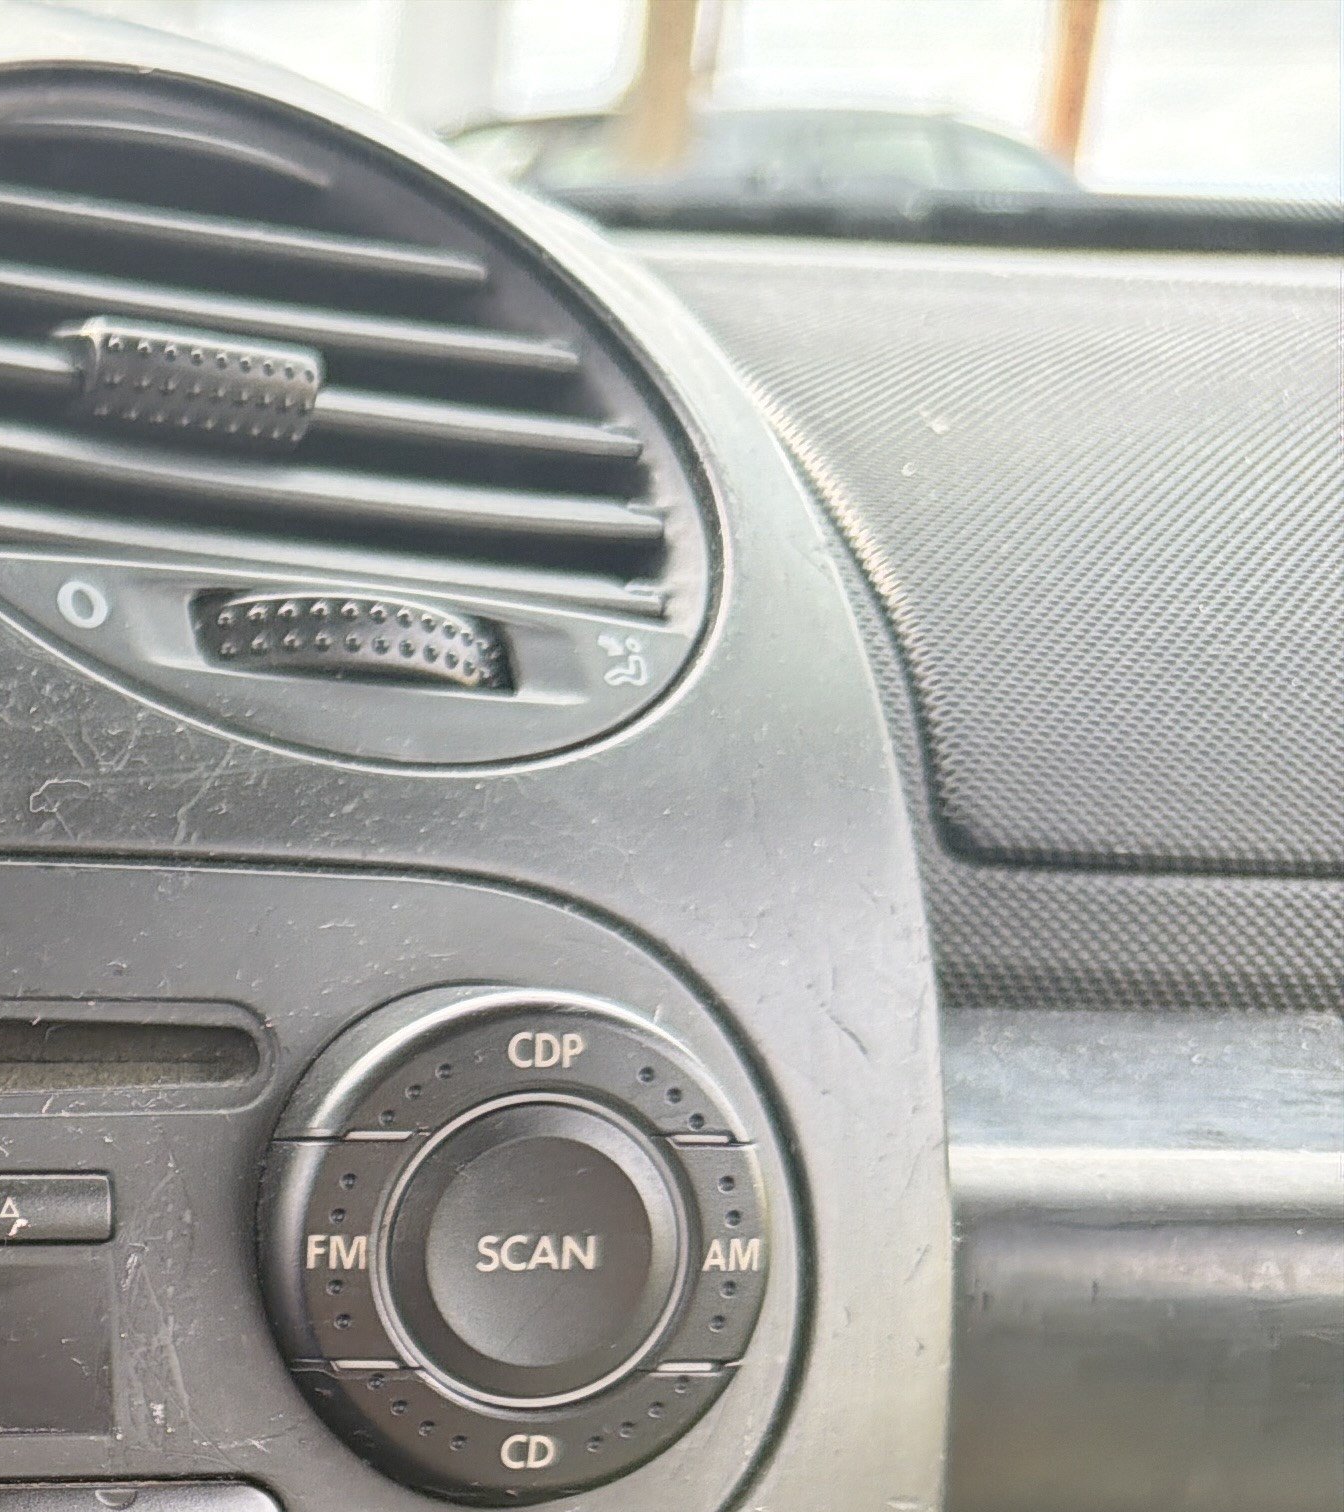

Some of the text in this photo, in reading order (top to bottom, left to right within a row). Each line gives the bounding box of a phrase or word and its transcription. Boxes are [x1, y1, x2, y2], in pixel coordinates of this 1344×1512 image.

[508, 1031, 586, 1069] CDP
[306, 1235, 367, 1270] FM
[475, 1235, 598, 1272] SCAN
[701, 1240, 762, 1271] AM
[500, 1434, 555, 1469] CD
